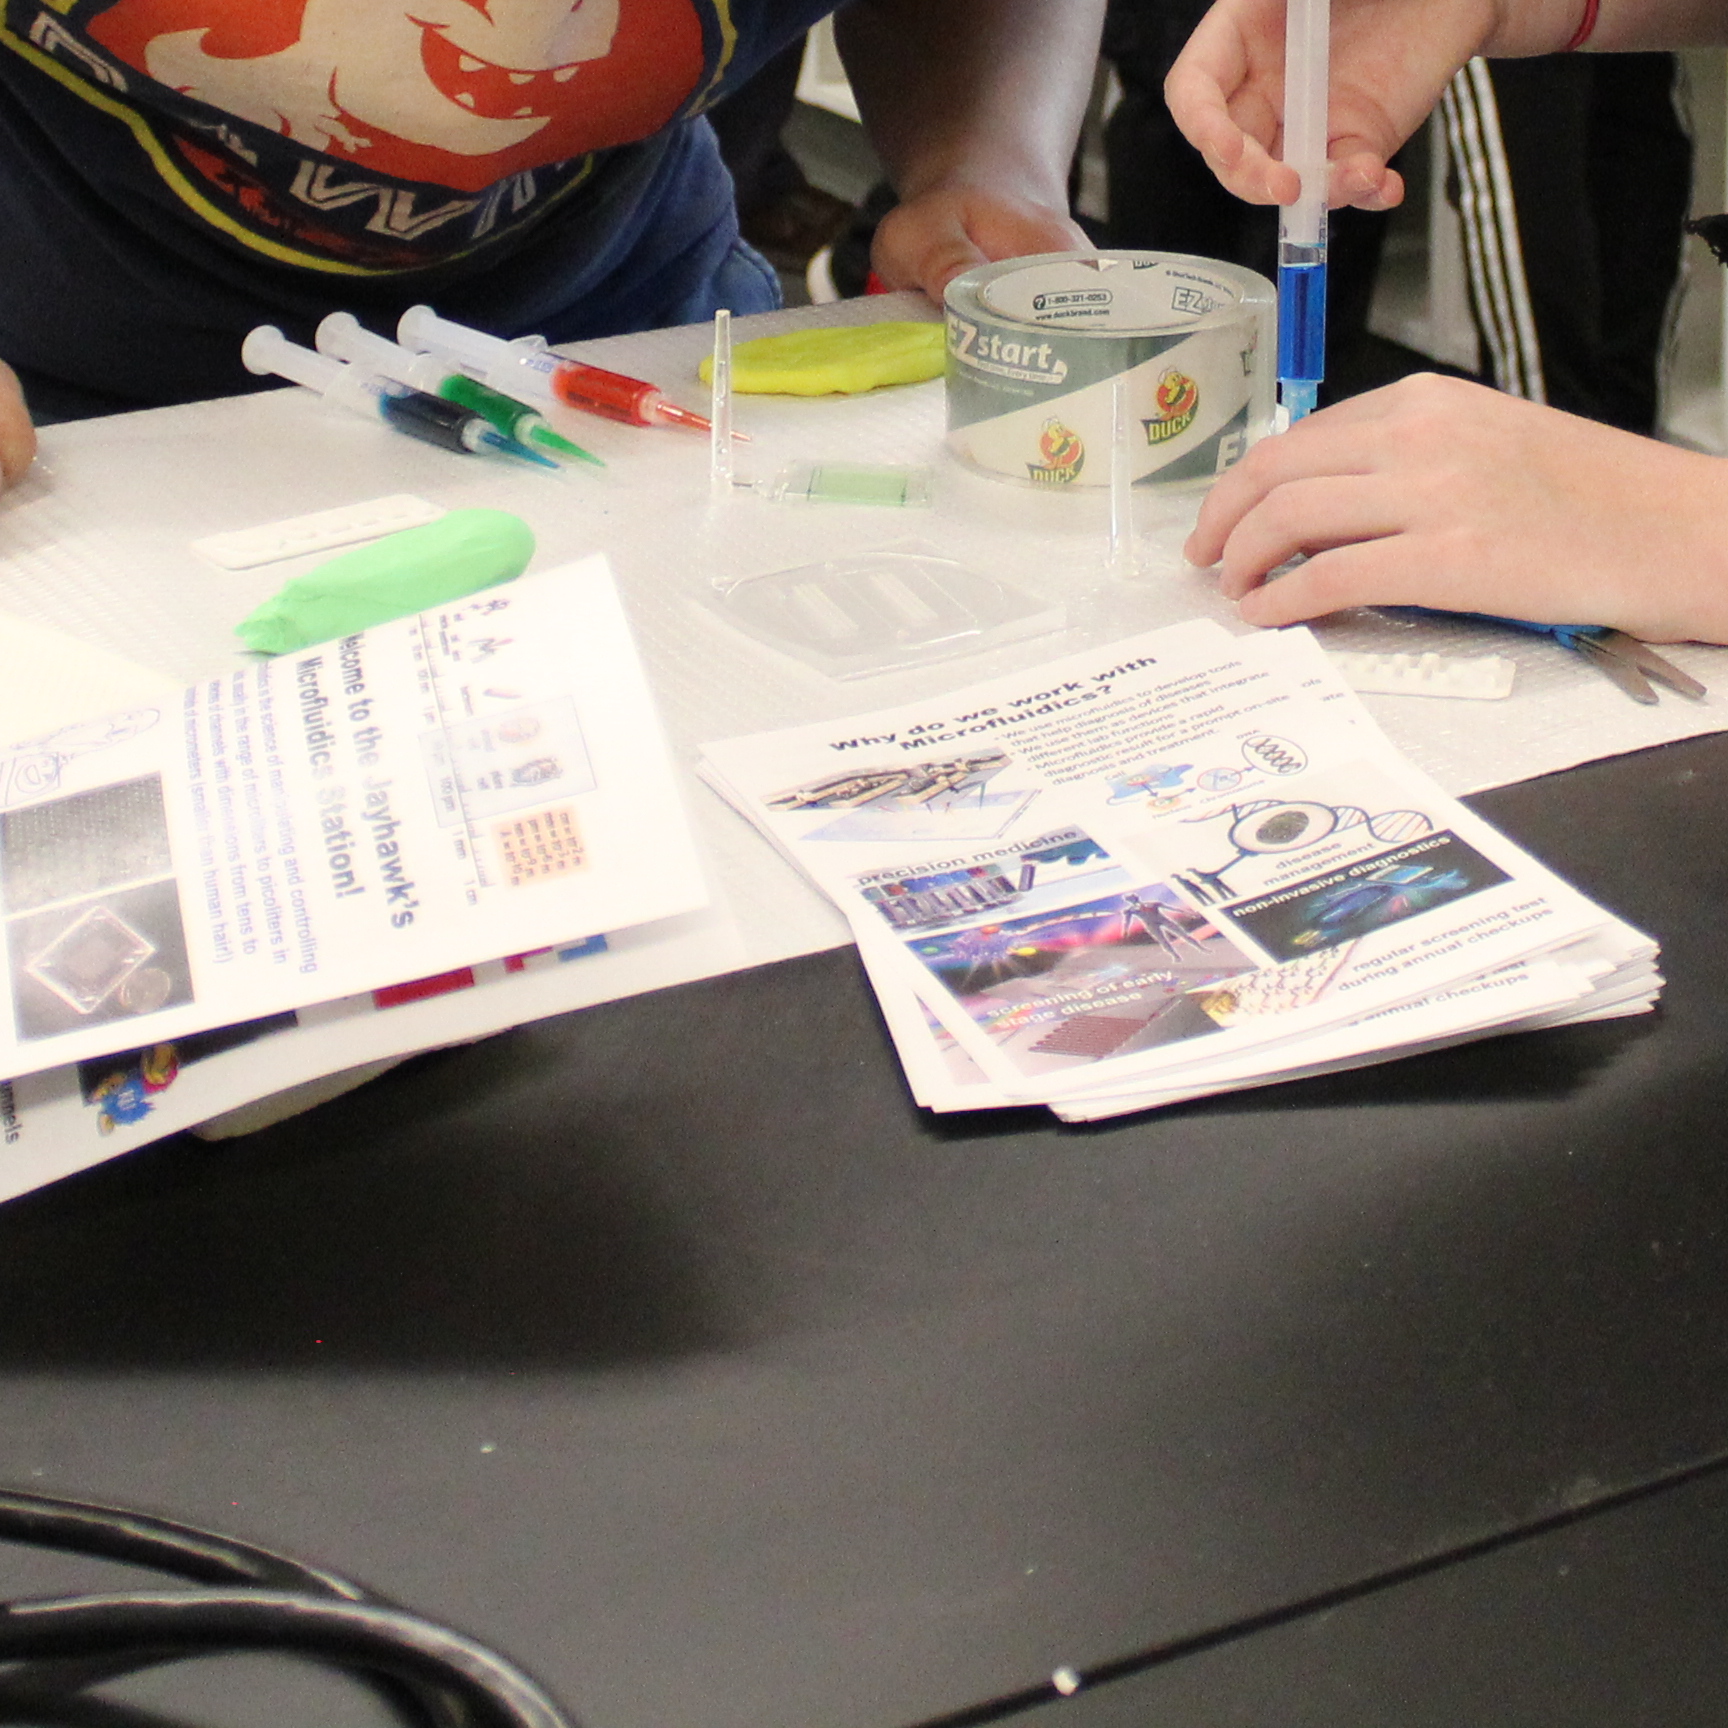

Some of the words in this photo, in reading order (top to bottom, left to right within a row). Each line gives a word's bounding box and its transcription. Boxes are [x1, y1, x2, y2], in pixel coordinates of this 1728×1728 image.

[1048, 294, 1107, 305] 1-800-321-0253
[977, 334, 1053, 369] start
[1148, 414, 1192, 443] DUCK
[296, 656, 336, 780] Microfluidics
[347, 697, 375, 723] to
[829, 733, 897, 752] Why
[907, 722, 944, 737] do
[953, 707, 999, 724] we
[1006, 680, 1084, 708] work
[1090, 656, 1158, 683] with
[899, 684, 1113, 751] Microfluidics?
[1001, 729, 1027, 740] We
[1028, 723, 1051, 735] use
[1052, 697, 1135, 729] microfluidics
[1136, 689, 1152, 701] to
[1154, 671, 1207, 699] develop
[1208, 660, 1242, 678] tools
[1011, 735, 1036, 747] that
[1038, 724, 1072, 741] help
[1073, 701, 1139, 731] diagnosis
[1140, 698, 1155, 709] of
[1155, 679, 1211, 703] diseases
[1020, 744, 1043, 756] We
[1044, 737, 1069, 748] use
[1070, 722, 1108, 742] them
[1110, 717, 1126, 726] as
[1128, 700, 1179, 721] devices
[1180, 690, 1208, 706] that
[1209, 671, 1269, 696] integrate
[235, 734, 252, 765] range
[267, 754, 284, 767] of
[353, 726, 383, 767] the
[1027, 742, 1085, 764] different
[1088, 734, 1110, 746] lab
[1111, 713, 1175, 739] functions
[1033, 741, 1122, 770] Microfluidics
[1124, 724, 1174, 747] provide
[1189, 704, 1224, 722] rapid
[1044, 753, 1113, 779] diagnostic
[1116, 739, 1150, 755] result
[1152, 732, 1174, 744] for
[1190, 709, 1242, 734] prompt
[214, 758, 231, 783] with
[242, 767, 259, 781] of
[1052, 762, 1115, 785] diagnosis
[1118, 751, 1144, 766] and
[217, 784, 241, 862] dimensions
[315, 784, 365, 899] Station!
[256, 856, 271, 872] to
[285, 858, 305, 886] and
[360, 776, 420, 930] Jayhawk's
[858, 856, 966, 887] precision
[972, 829, 1077, 863] medicine
[1263, 842, 1376, 887] management
[1275, 841, 1342, 872] disease
[230, 864, 247, 899] from
[1231, 871, 1346, 919] non-invasive
[1348, 836, 1451, 884] diagnostics
[203, 869, 220, 920] human
[212, 922, 235, 964] hair!)
[236, 901, 254, 935] tens
[256, 875, 283, 946] picoliters
[290, 889, 318, 974] controlling
[242, 937, 258, 955] to
[273, 948, 290, 964] in
[1337, 960, 1399, 993] during
[1402, 942, 1464, 968] annual
[1466, 908, 1554, 943] checkups
[1352, 943, 1418, 973] regular
[1421, 910, 1511, 944] screening
[1513, 897, 1548, 913] test
[986, 986, 1090, 1018] screening
[1094, 981, 1119, 996] of
[1119, 970, 1173, 991] early
[1059, 990, 1142, 1015] disease
[1435, 973, 1529, 1003] checkups
[0, 1081, 23, 1145] unnels
